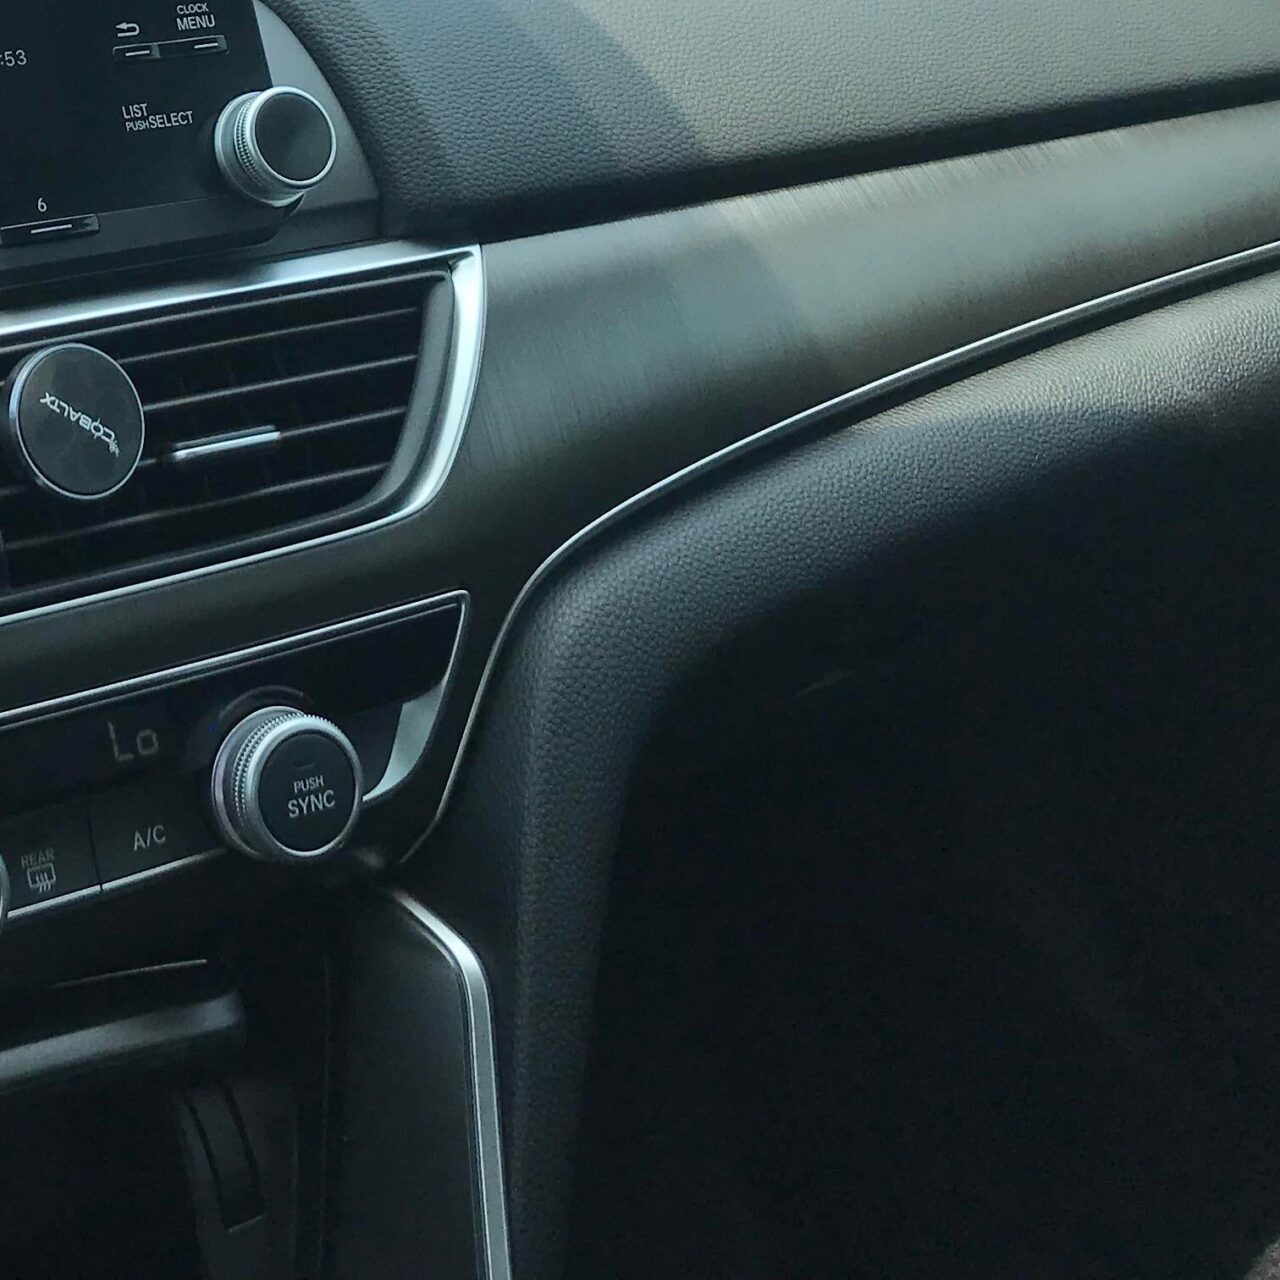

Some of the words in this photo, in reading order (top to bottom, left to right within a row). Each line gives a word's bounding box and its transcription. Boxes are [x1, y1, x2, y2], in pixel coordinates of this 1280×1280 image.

[176, 2, 209, 15] CLOCK
[176, 14, 216, 31] MENU
[122, 103, 148, 119] LIST
[125, 120, 150, 132] PUSH
[149, 111, 193, 129] SELECT
[37, 197, 48, 212] 6
[108, 721, 160, 762] Lo
[293, 775, 325, 793] PUSH
[287, 789, 335, 818] SYNC
[133, 824, 167, 851] A/C
[20, 848, 55, 869] REAR
